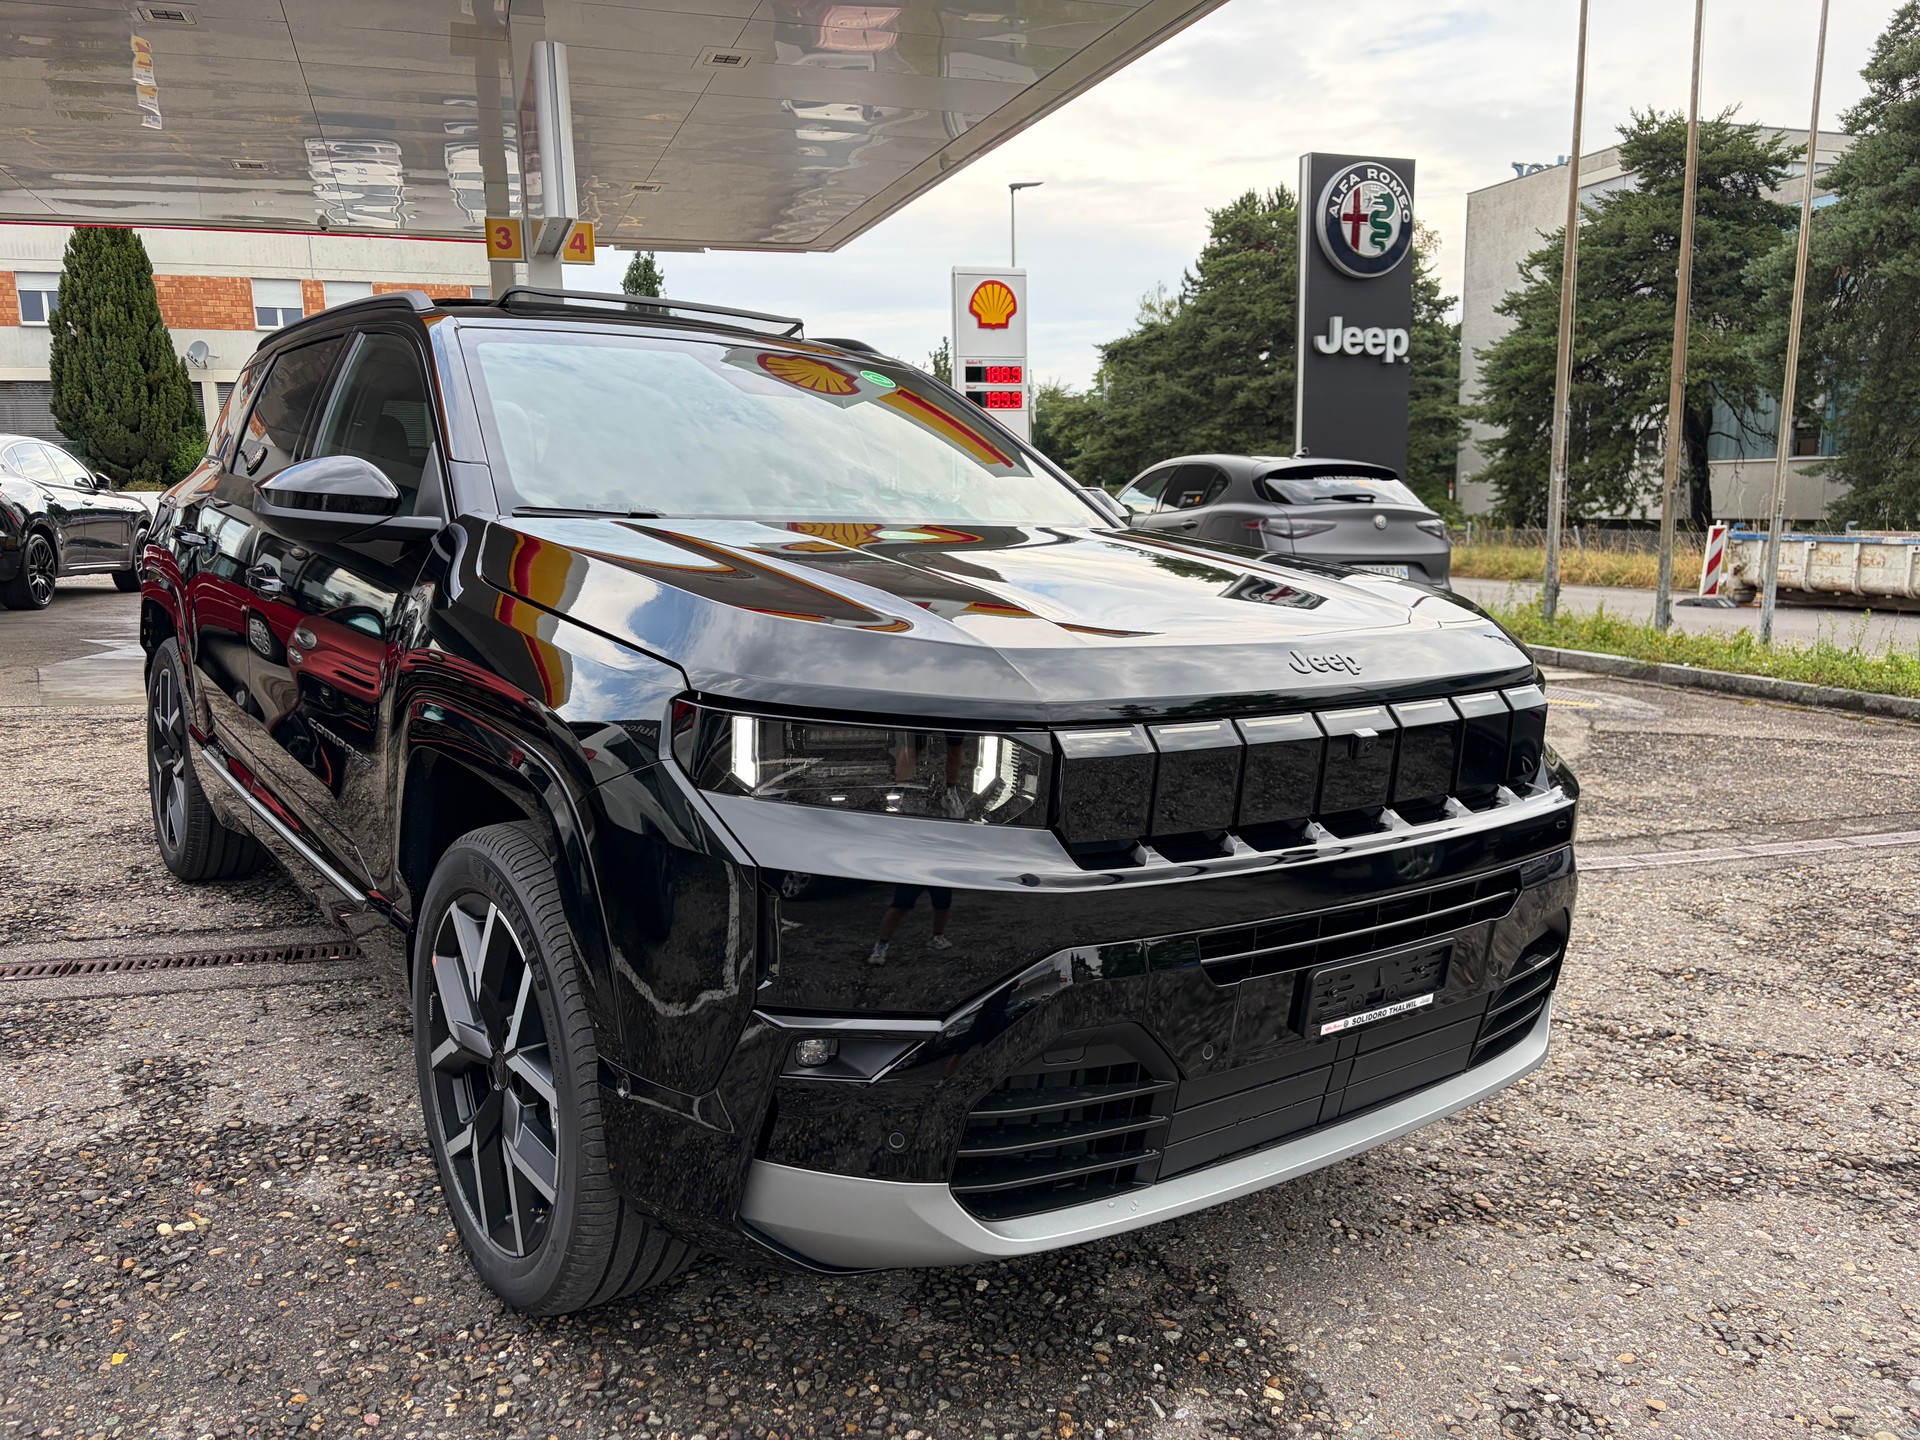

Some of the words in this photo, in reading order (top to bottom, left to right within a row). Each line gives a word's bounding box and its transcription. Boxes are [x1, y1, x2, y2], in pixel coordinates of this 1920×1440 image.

[1328, 173, 1361, 219] ALFA
[1367, 168, 1410, 224] ROMEO
[495, 226, 513, 250] 3
[569, 233, 588, 254] 4
[1315, 316, 1410, 363] Jeep
[986, 366, 1021, 383] 188.9
[986, 391, 1021, 408] 199.9
[1288, 650, 1362, 676] Jeep
[308, 717, 372, 769] COMPASS
[487, 871, 547, 985] MICHELIN
[1351, 1009, 1388, 1026] SOLIDORO
[1388, 1000, 1417, 1015] THALWIL
